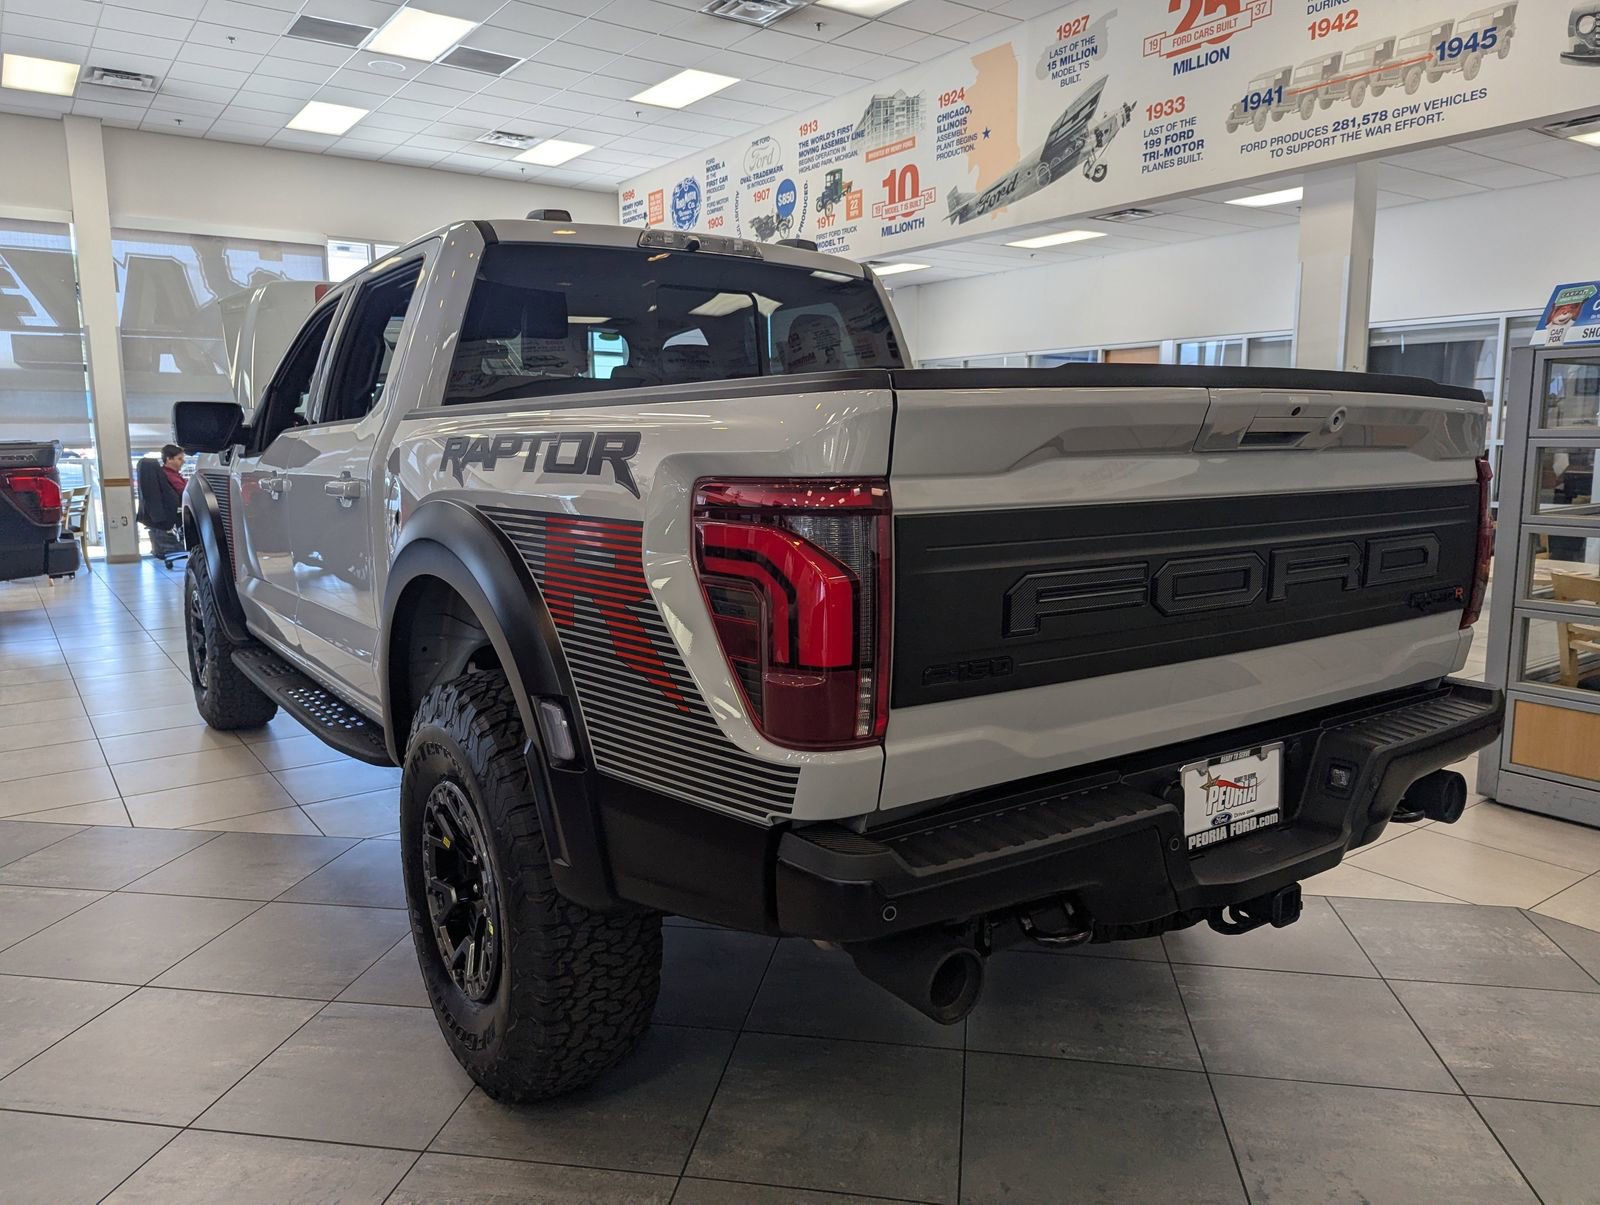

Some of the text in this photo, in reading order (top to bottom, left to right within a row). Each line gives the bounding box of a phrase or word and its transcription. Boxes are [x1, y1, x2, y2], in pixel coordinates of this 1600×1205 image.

[1254, 1, 1267, 16] 37
[1056, 14, 1090, 41] 1927
[1172, 17, 1238, 48] FORD CARS BUILT
[1307, 9, 1359, 40] 1942
[1049, 35, 1095, 59] LAST OF THE
[1149, 38, 1158, 51] 19
[1435, 26, 1498, 62] 1945
[1047, 45, 1098, 72] 15 MILLION
[1173, 45, 1230, 75] MILLION
[1051, 65, 1077, 80] MODEL
[938, 87, 965, 108] 1924
[1146, 96, 1185, 121] 1933
[1241, 85, 1283, 112] 1941
[936, 105, 972, 123] CHICAGO,
[1240, 88, 1488, 154] FORD PRODUCES 281,578 GPW VEHICLES
[798, 124, 853, 149] THE WORLD'S FIRST
[799, 120, 818, 137] 1913
[936, 117, 967, 134] ILLINOIS
[936, 127, 967, 143] ASSEMBLY
[1144, 116, 1197, 138] LAST OF THE
[1270, 112, 1446, 158] TO SUPPORT THE WAR EFFORT.
[799, 129, 865, 159] MOVING ASSEMBLY LINE
[936, 133, 978, 153] PLANT BEGINS
[1143, 128, 1194, 150] 199 FORD
[798, 157, 815, 167] BEGINS
[815, 148, 841, 161] OPERATION
[936, 144, 976, 161] PRODUCTION.
[1142, 139, 1204, 163] TRI-MOTOR
[798, 162, 821, 175] HIGHLAND
[1141, 152, 1204, 174] PLANES BUILT.
[706, 175, 728, 188] FIRST CAR
[740, 165, 784, 184] OVAL TRADEMARK
[753, 188, 771, 203] 1907
[882, 164, 920, 221] 10
[977, 172, 1019, 215] Ford
[884, 205, 899, 215] MODEL
[909, 199, 922, 209] BUILT
[708, 216, 723, 229] 1903
[816, 214, 836, 230] 1917
[816, 226, 857, 240] FIRST FORD TRUCK
[881, 217, 925, 237] MILLIONTH
[816, 237, 845, 250] MODEL TT
[1549, 335, 1562, 343] FOX
[1550, 328, 1564, 336] CAR
[439, 431, 642, 499] RAPTOR
[1002, 531, 1440, 639] FORD
[544, 517, 692, 713] R
[921, 655, 1014, 688] F-150
[1206, 777, 1258, 816] PEORIA
[1188, 826, 1228, 850] PEORIA
